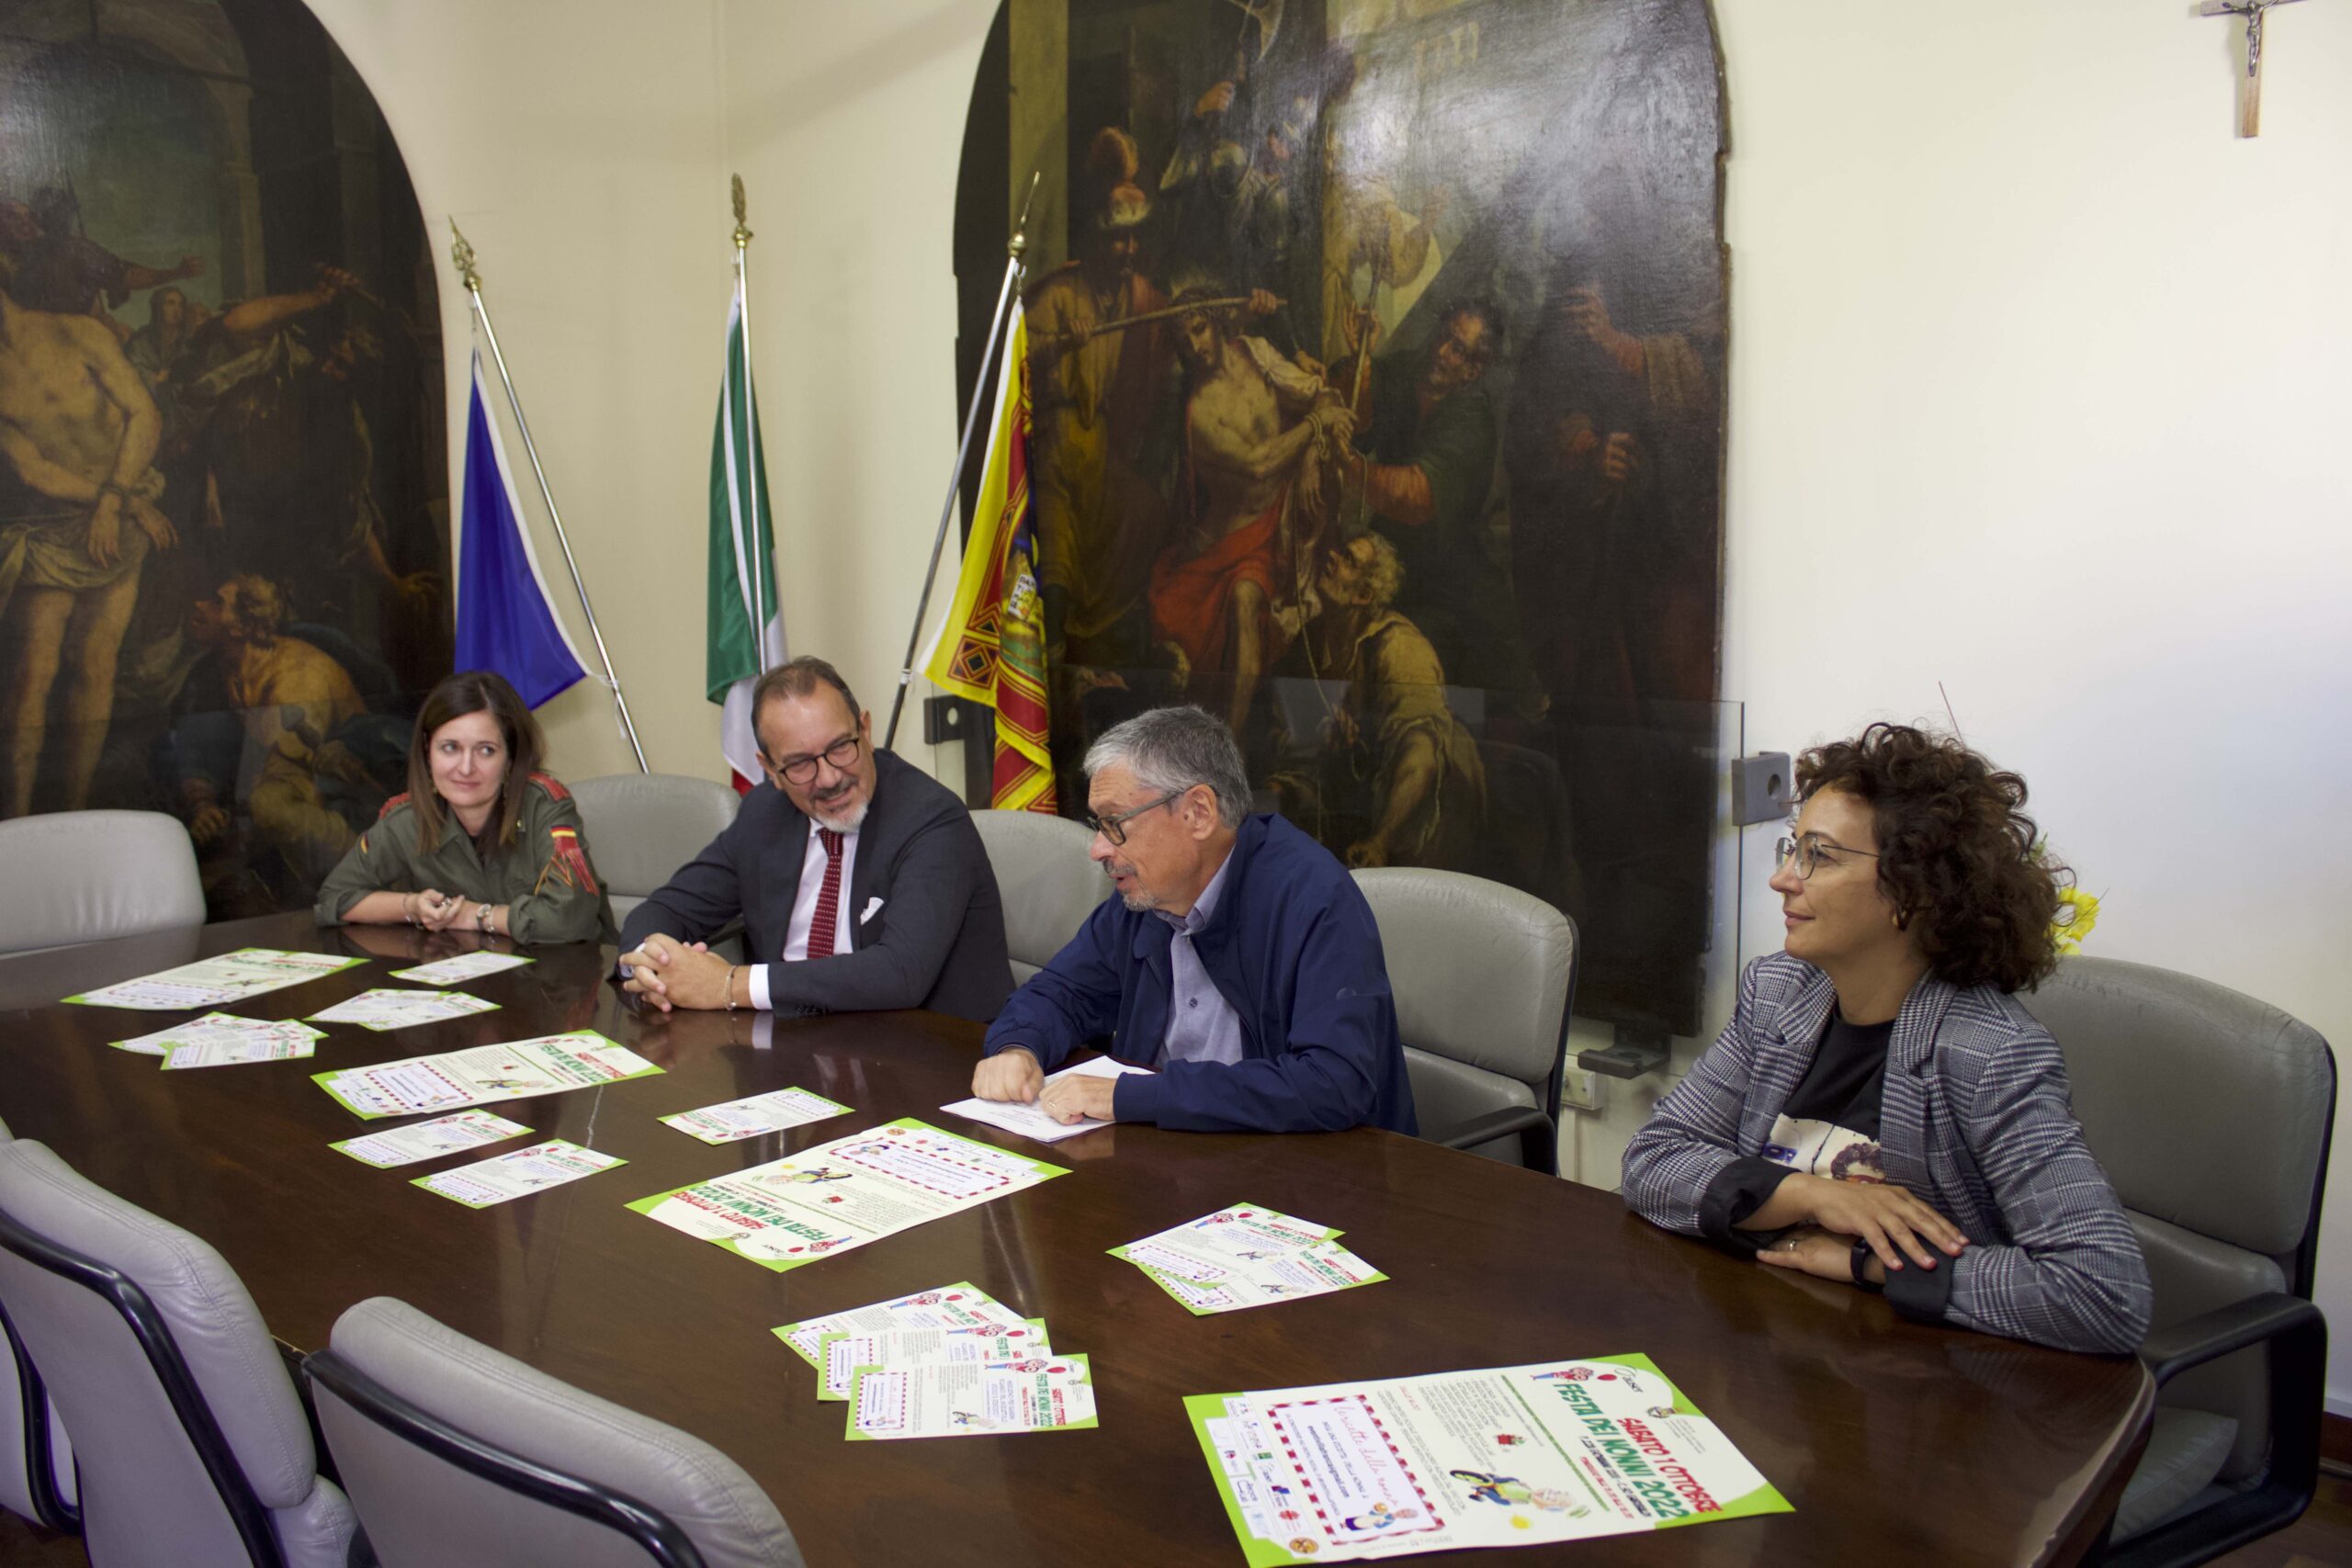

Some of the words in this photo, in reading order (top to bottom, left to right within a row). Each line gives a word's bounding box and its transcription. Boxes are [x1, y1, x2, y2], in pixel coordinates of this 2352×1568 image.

[671, 1190, 721, 1211] OTTOBRE
[686, 1185, 731, 1201] 2022
[727, 1201, 771, 1217] NONNI
[720, 1213, 766, 1229] SABATO
[763, 1216, 788, 1225] DEI
[783, 1223, 829, 1241] FESTA
[1556, 1384, 1603, 1416] FESTA
[1584, 1419, 1619, 1435] DEI
[1601, 1439, 1653, 1476] NONNI
[1618, 1418, 1670, 1455] SABATO
[1659, 1466, 1722, 1512] OTTOBRE
[1633, 1482, 1692, 1517] 2022
